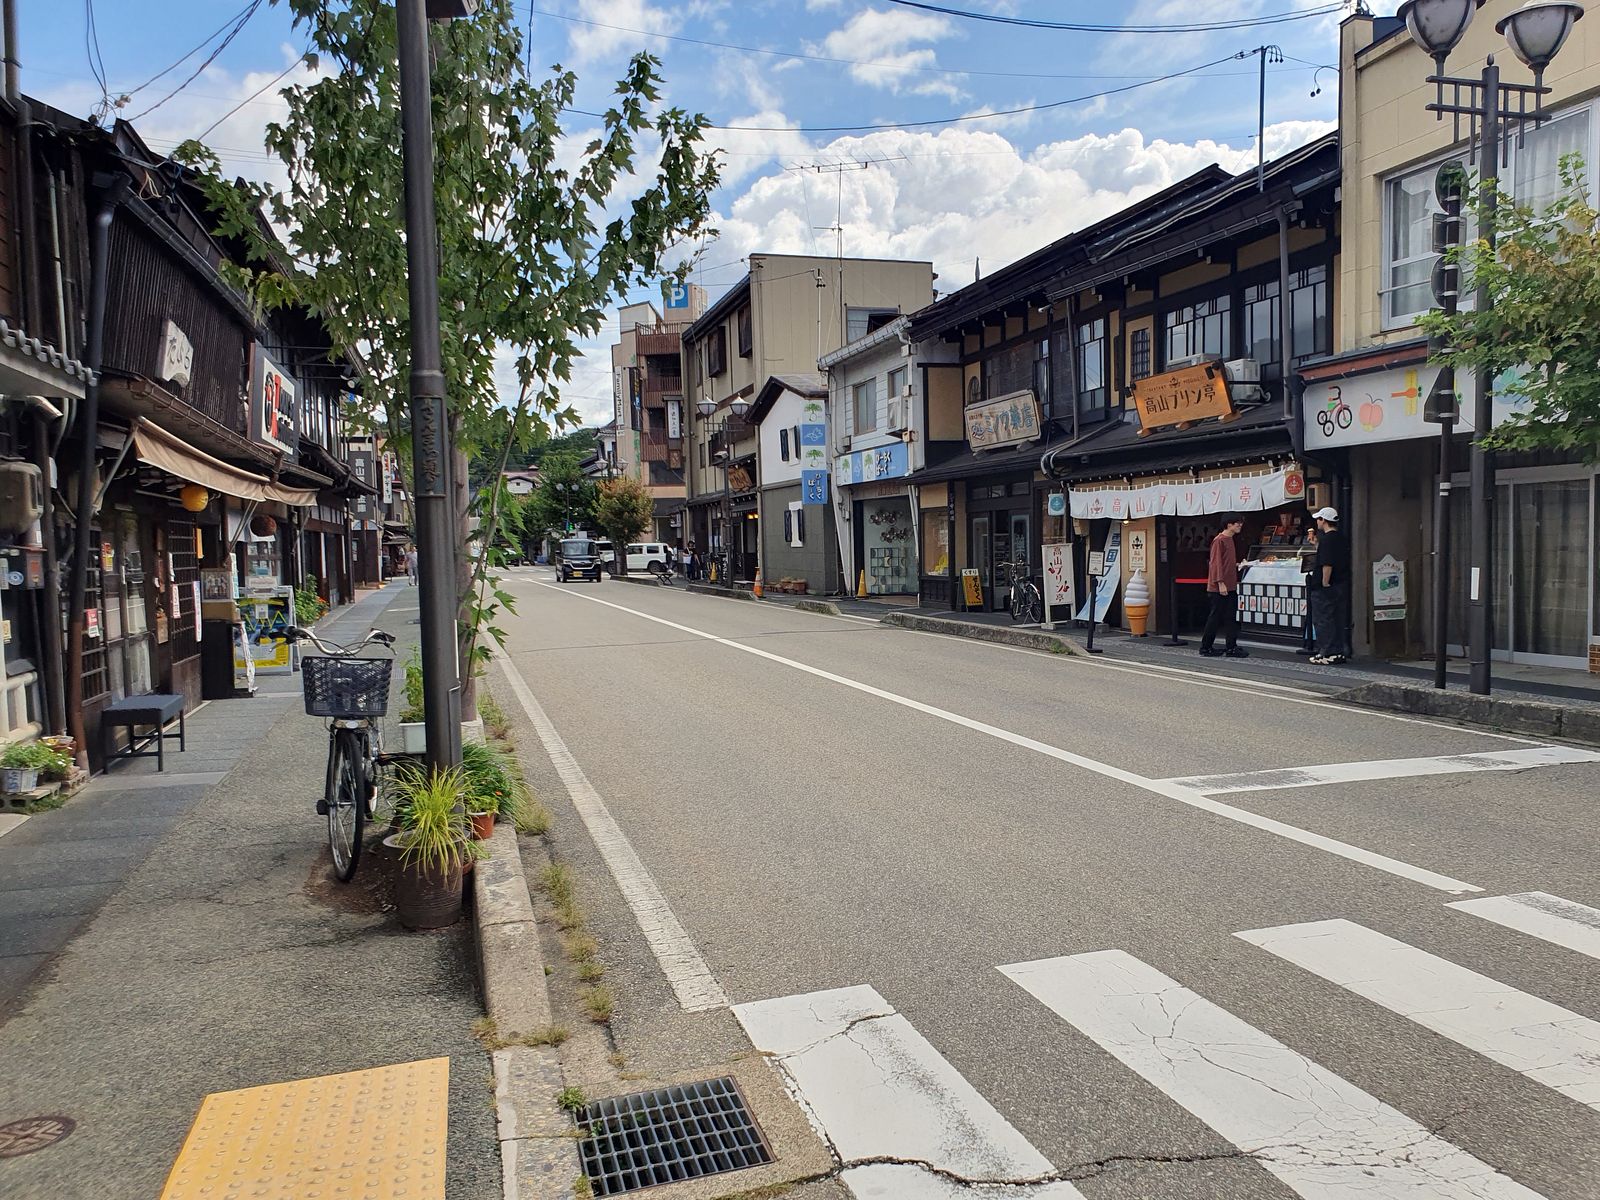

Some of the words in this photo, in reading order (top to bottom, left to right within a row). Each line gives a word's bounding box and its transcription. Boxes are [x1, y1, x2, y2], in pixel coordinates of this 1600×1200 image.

[671, 286, 685, 307] P
[1144, 383, 1216, 415] 高山プリン亭
[1111, 484, 1253, 514] 高山プリン亭
[1053, 546, 1065, 602] 高山プリン亭
